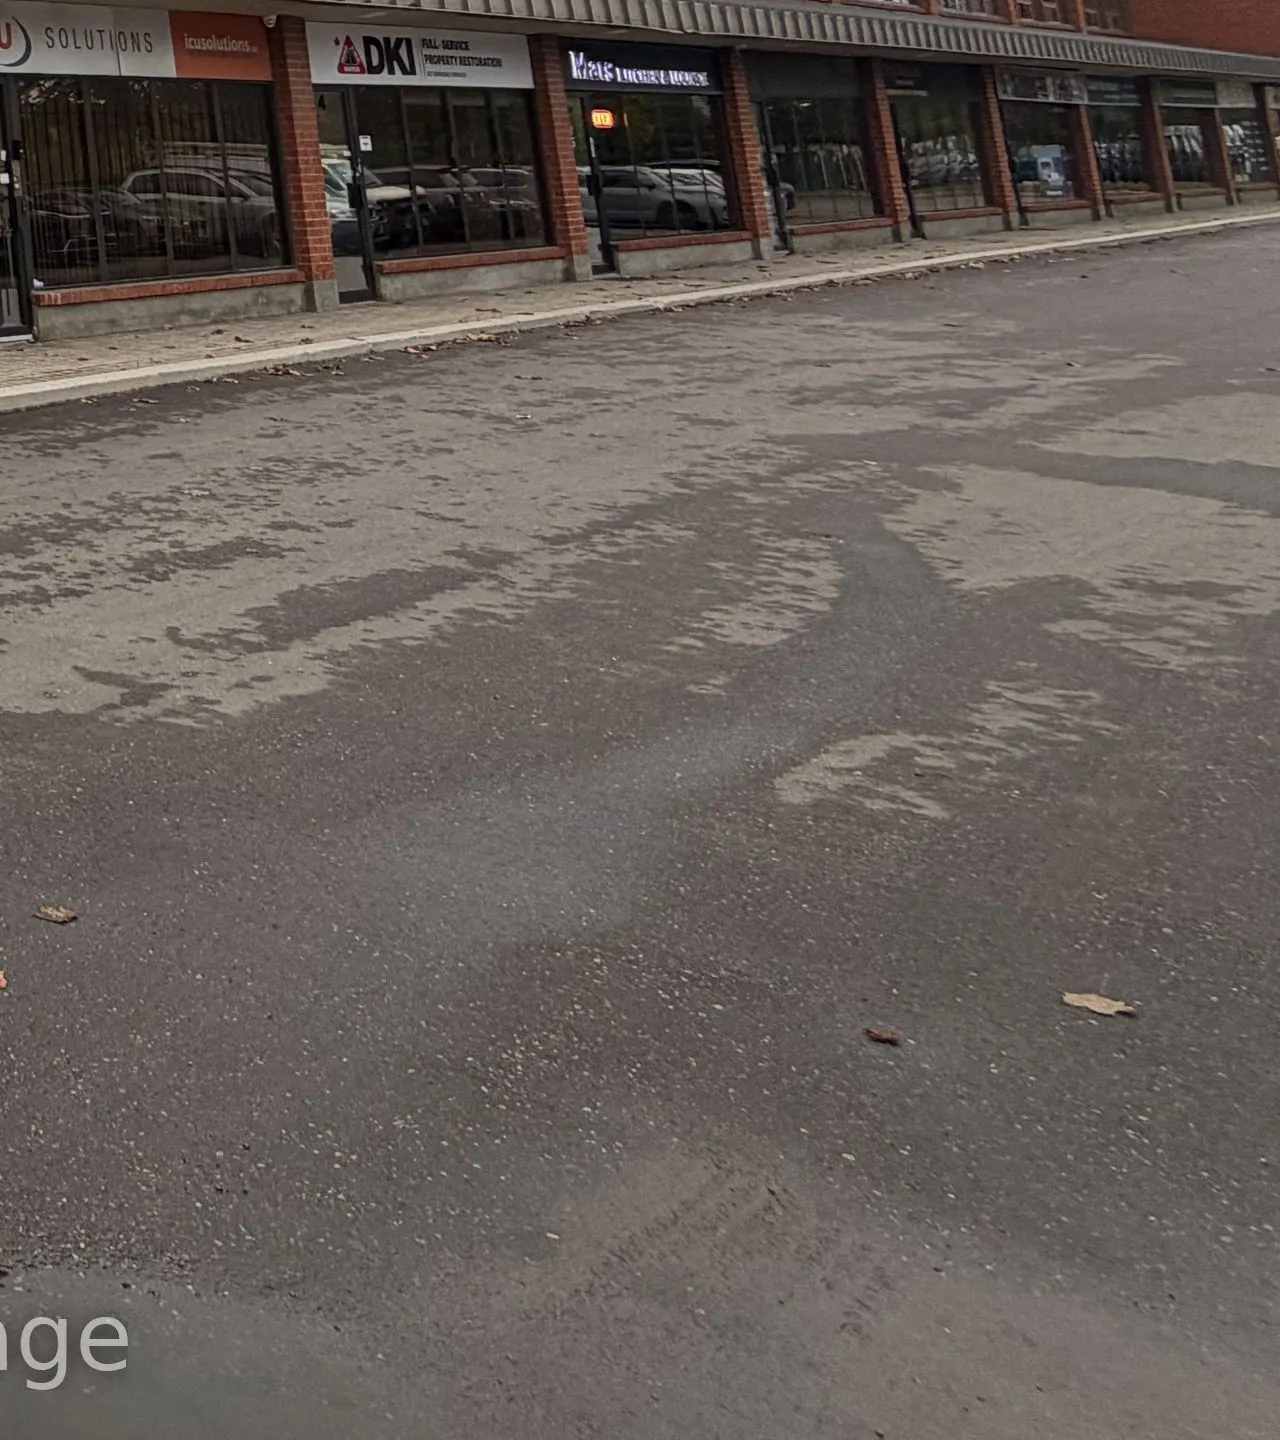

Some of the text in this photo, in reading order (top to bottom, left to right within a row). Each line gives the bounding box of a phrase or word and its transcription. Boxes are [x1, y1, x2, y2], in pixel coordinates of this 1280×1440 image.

[44, 26, 154, 54] SOLUTIONS
[362, 35, 417, 76] DKI
[424, 54, 503, 68] PROPERTY RESTORATION
